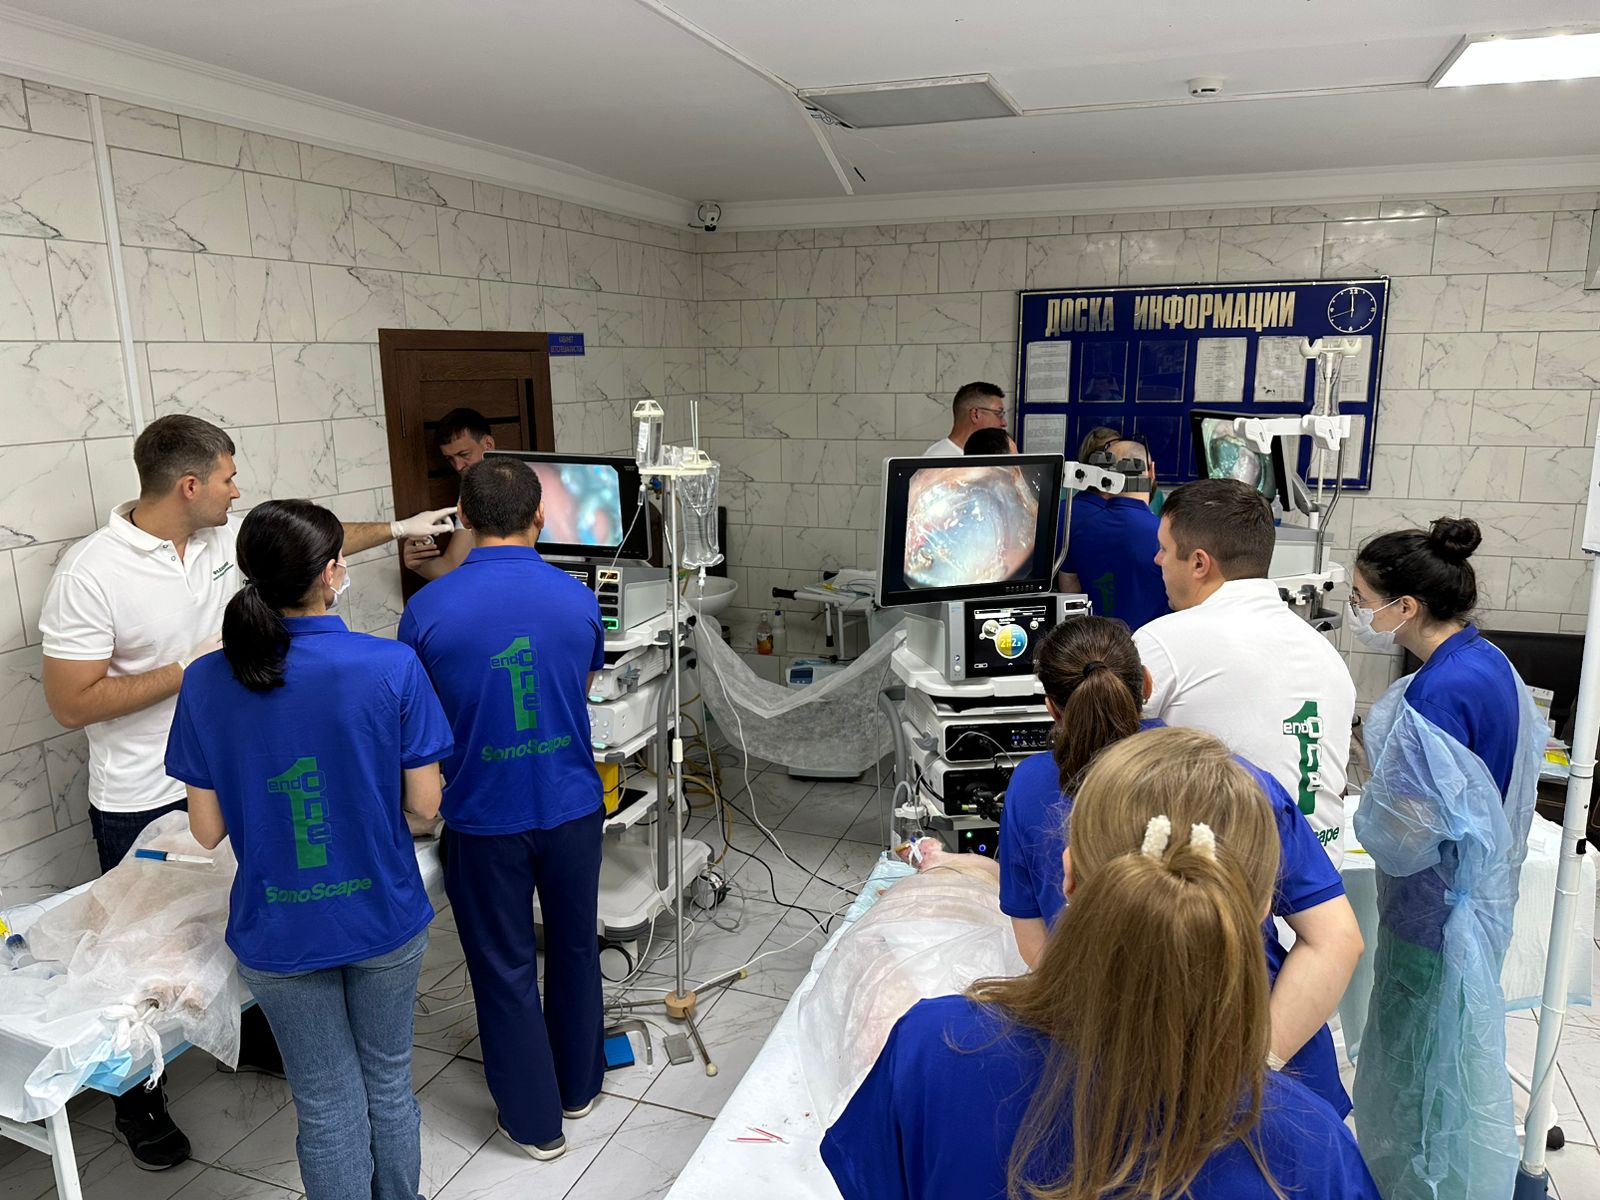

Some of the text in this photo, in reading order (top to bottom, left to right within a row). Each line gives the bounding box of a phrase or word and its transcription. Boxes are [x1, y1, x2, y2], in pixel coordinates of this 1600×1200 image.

[1045, 291, 1296, 337] ДОСКА ИНФОРМАЦИИ
[481, 735, 572, 761] SonoScape
[265, 878, 373, 904] SonoScape
